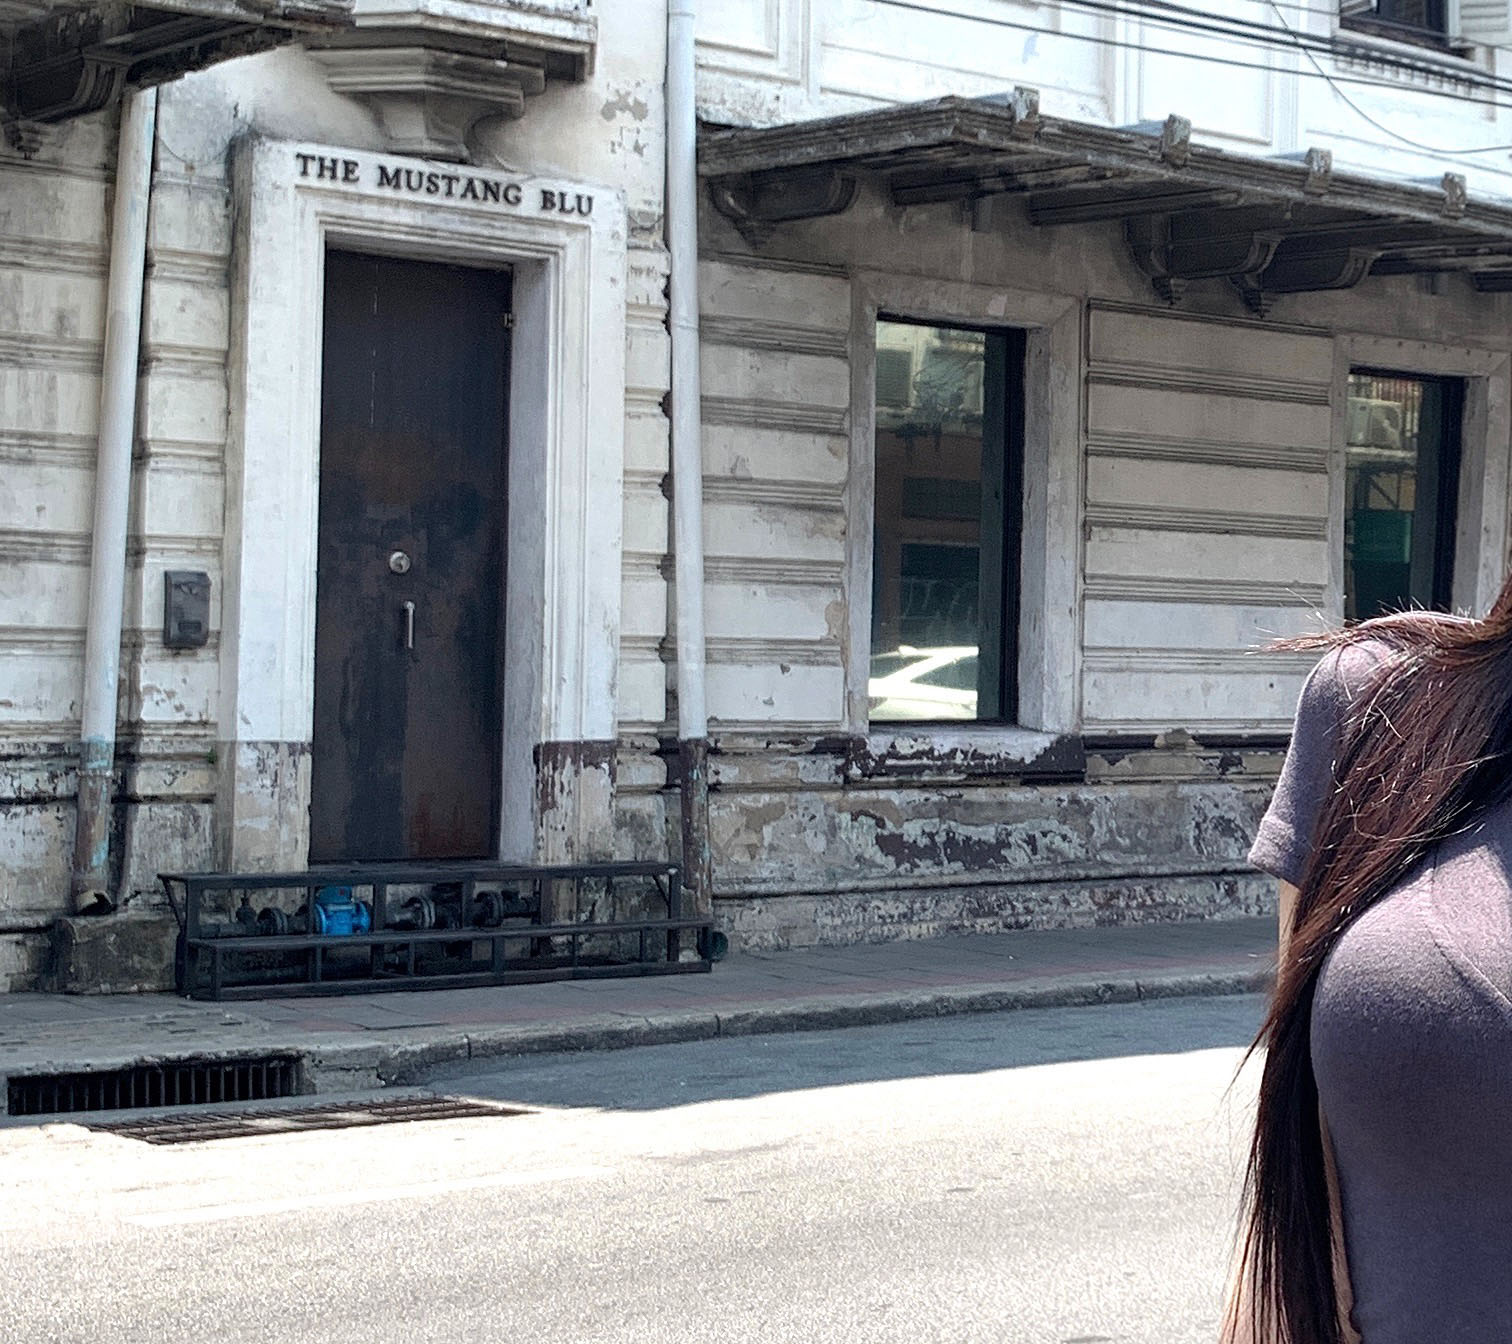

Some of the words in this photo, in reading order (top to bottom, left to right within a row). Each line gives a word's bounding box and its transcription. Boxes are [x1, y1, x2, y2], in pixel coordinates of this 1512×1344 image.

[296, 154, 360, 183] THE
[377, 165, 522, 206] MUSTANG
[540, 189, 594, 216] BLU
